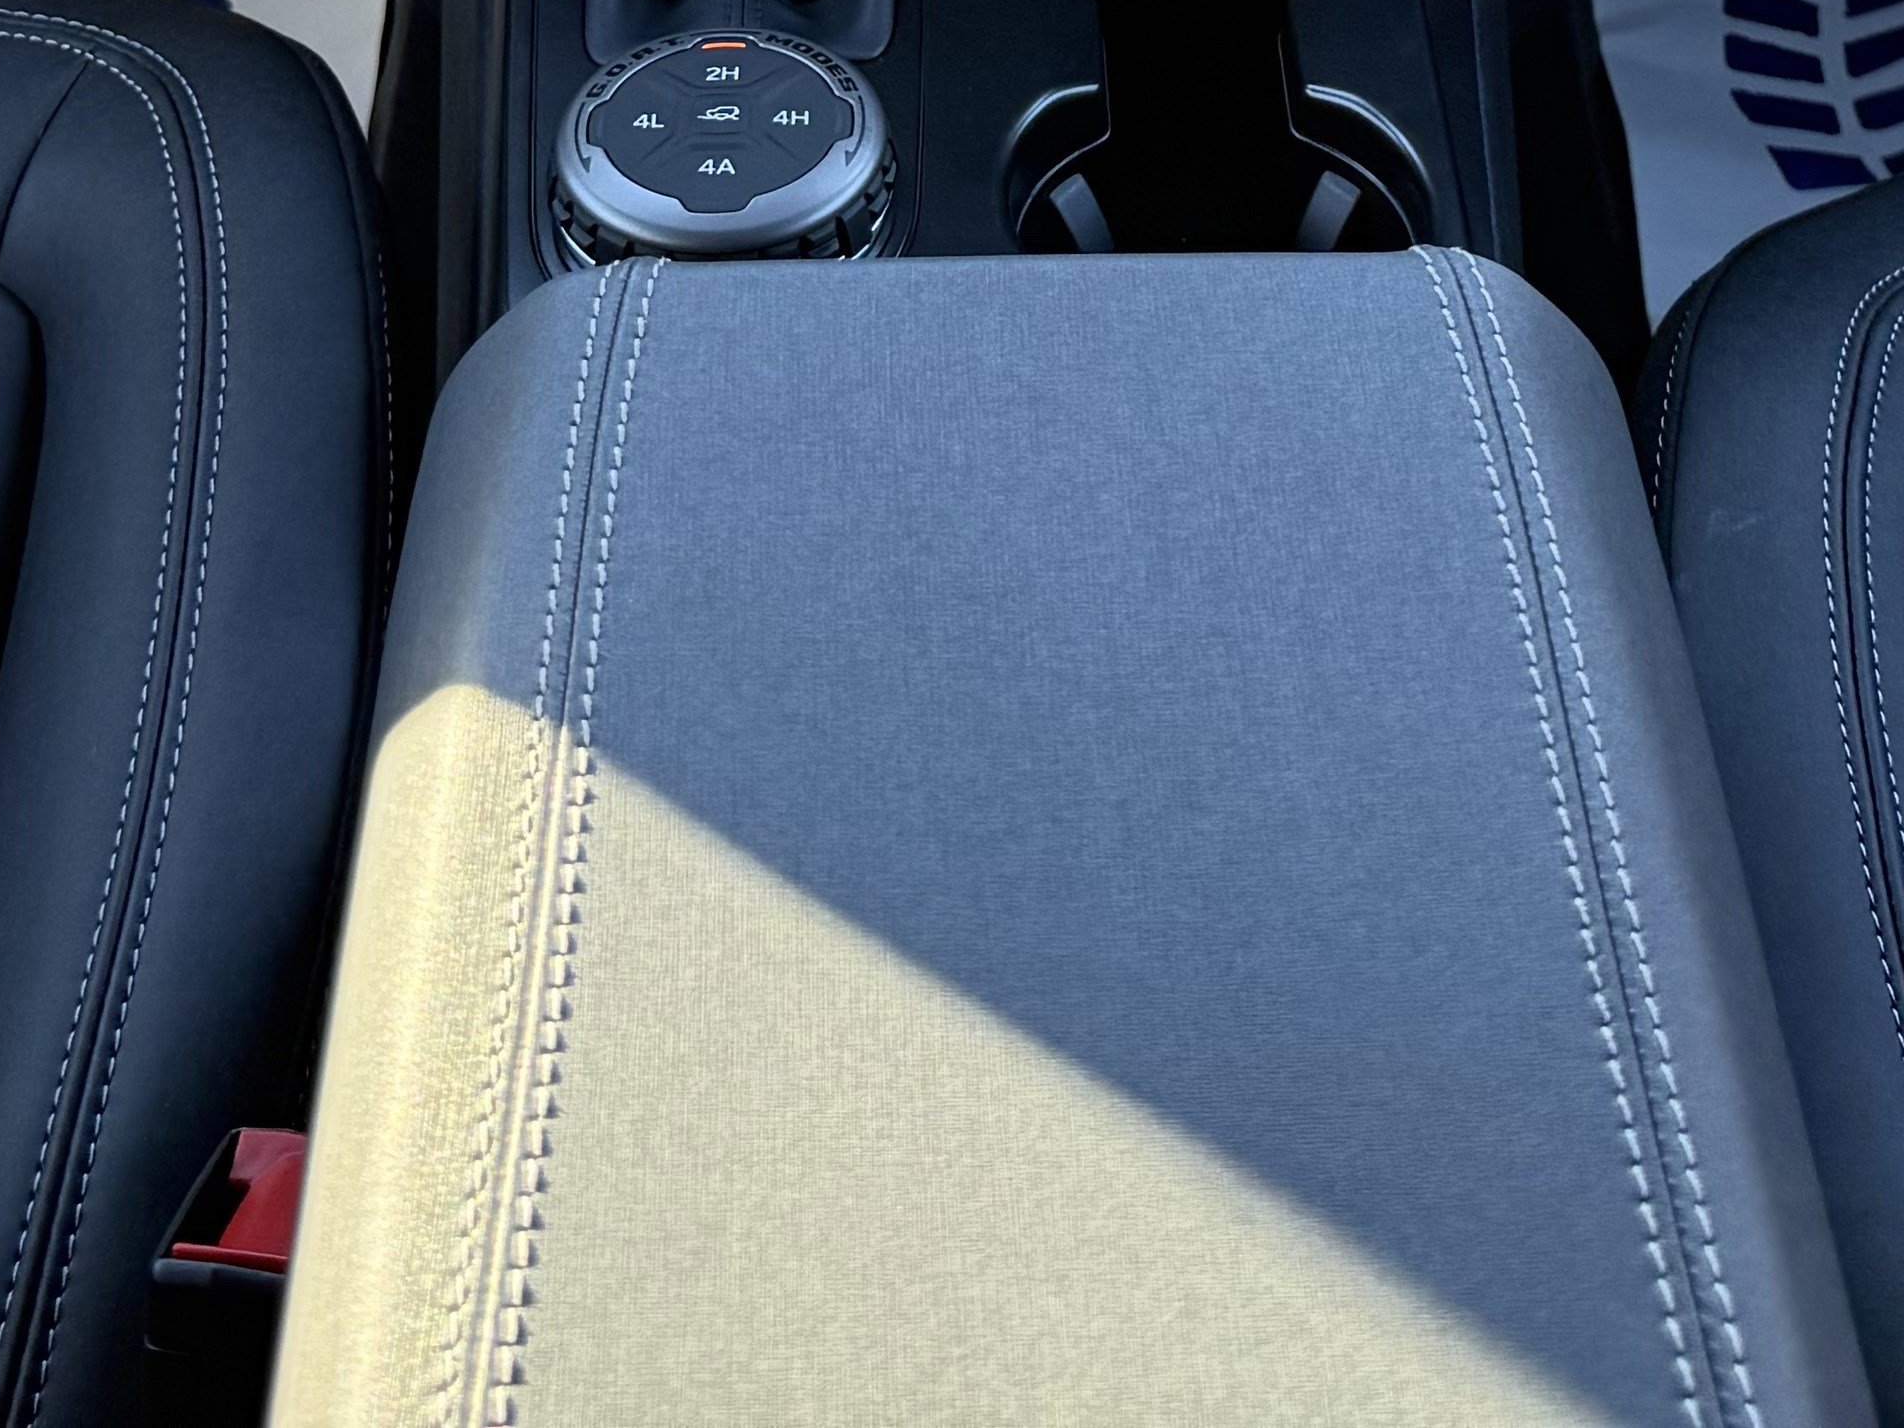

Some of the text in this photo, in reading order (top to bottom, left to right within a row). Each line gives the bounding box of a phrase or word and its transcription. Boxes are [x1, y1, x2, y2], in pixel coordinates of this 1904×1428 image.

[765, 33, 860, 93] MODES
[706, 67, 739, 81] 2H
[633, 114, 664, 128] 4L
[773, 111, 809, 125] 4H
[698, 159, 735, 174] 4A
